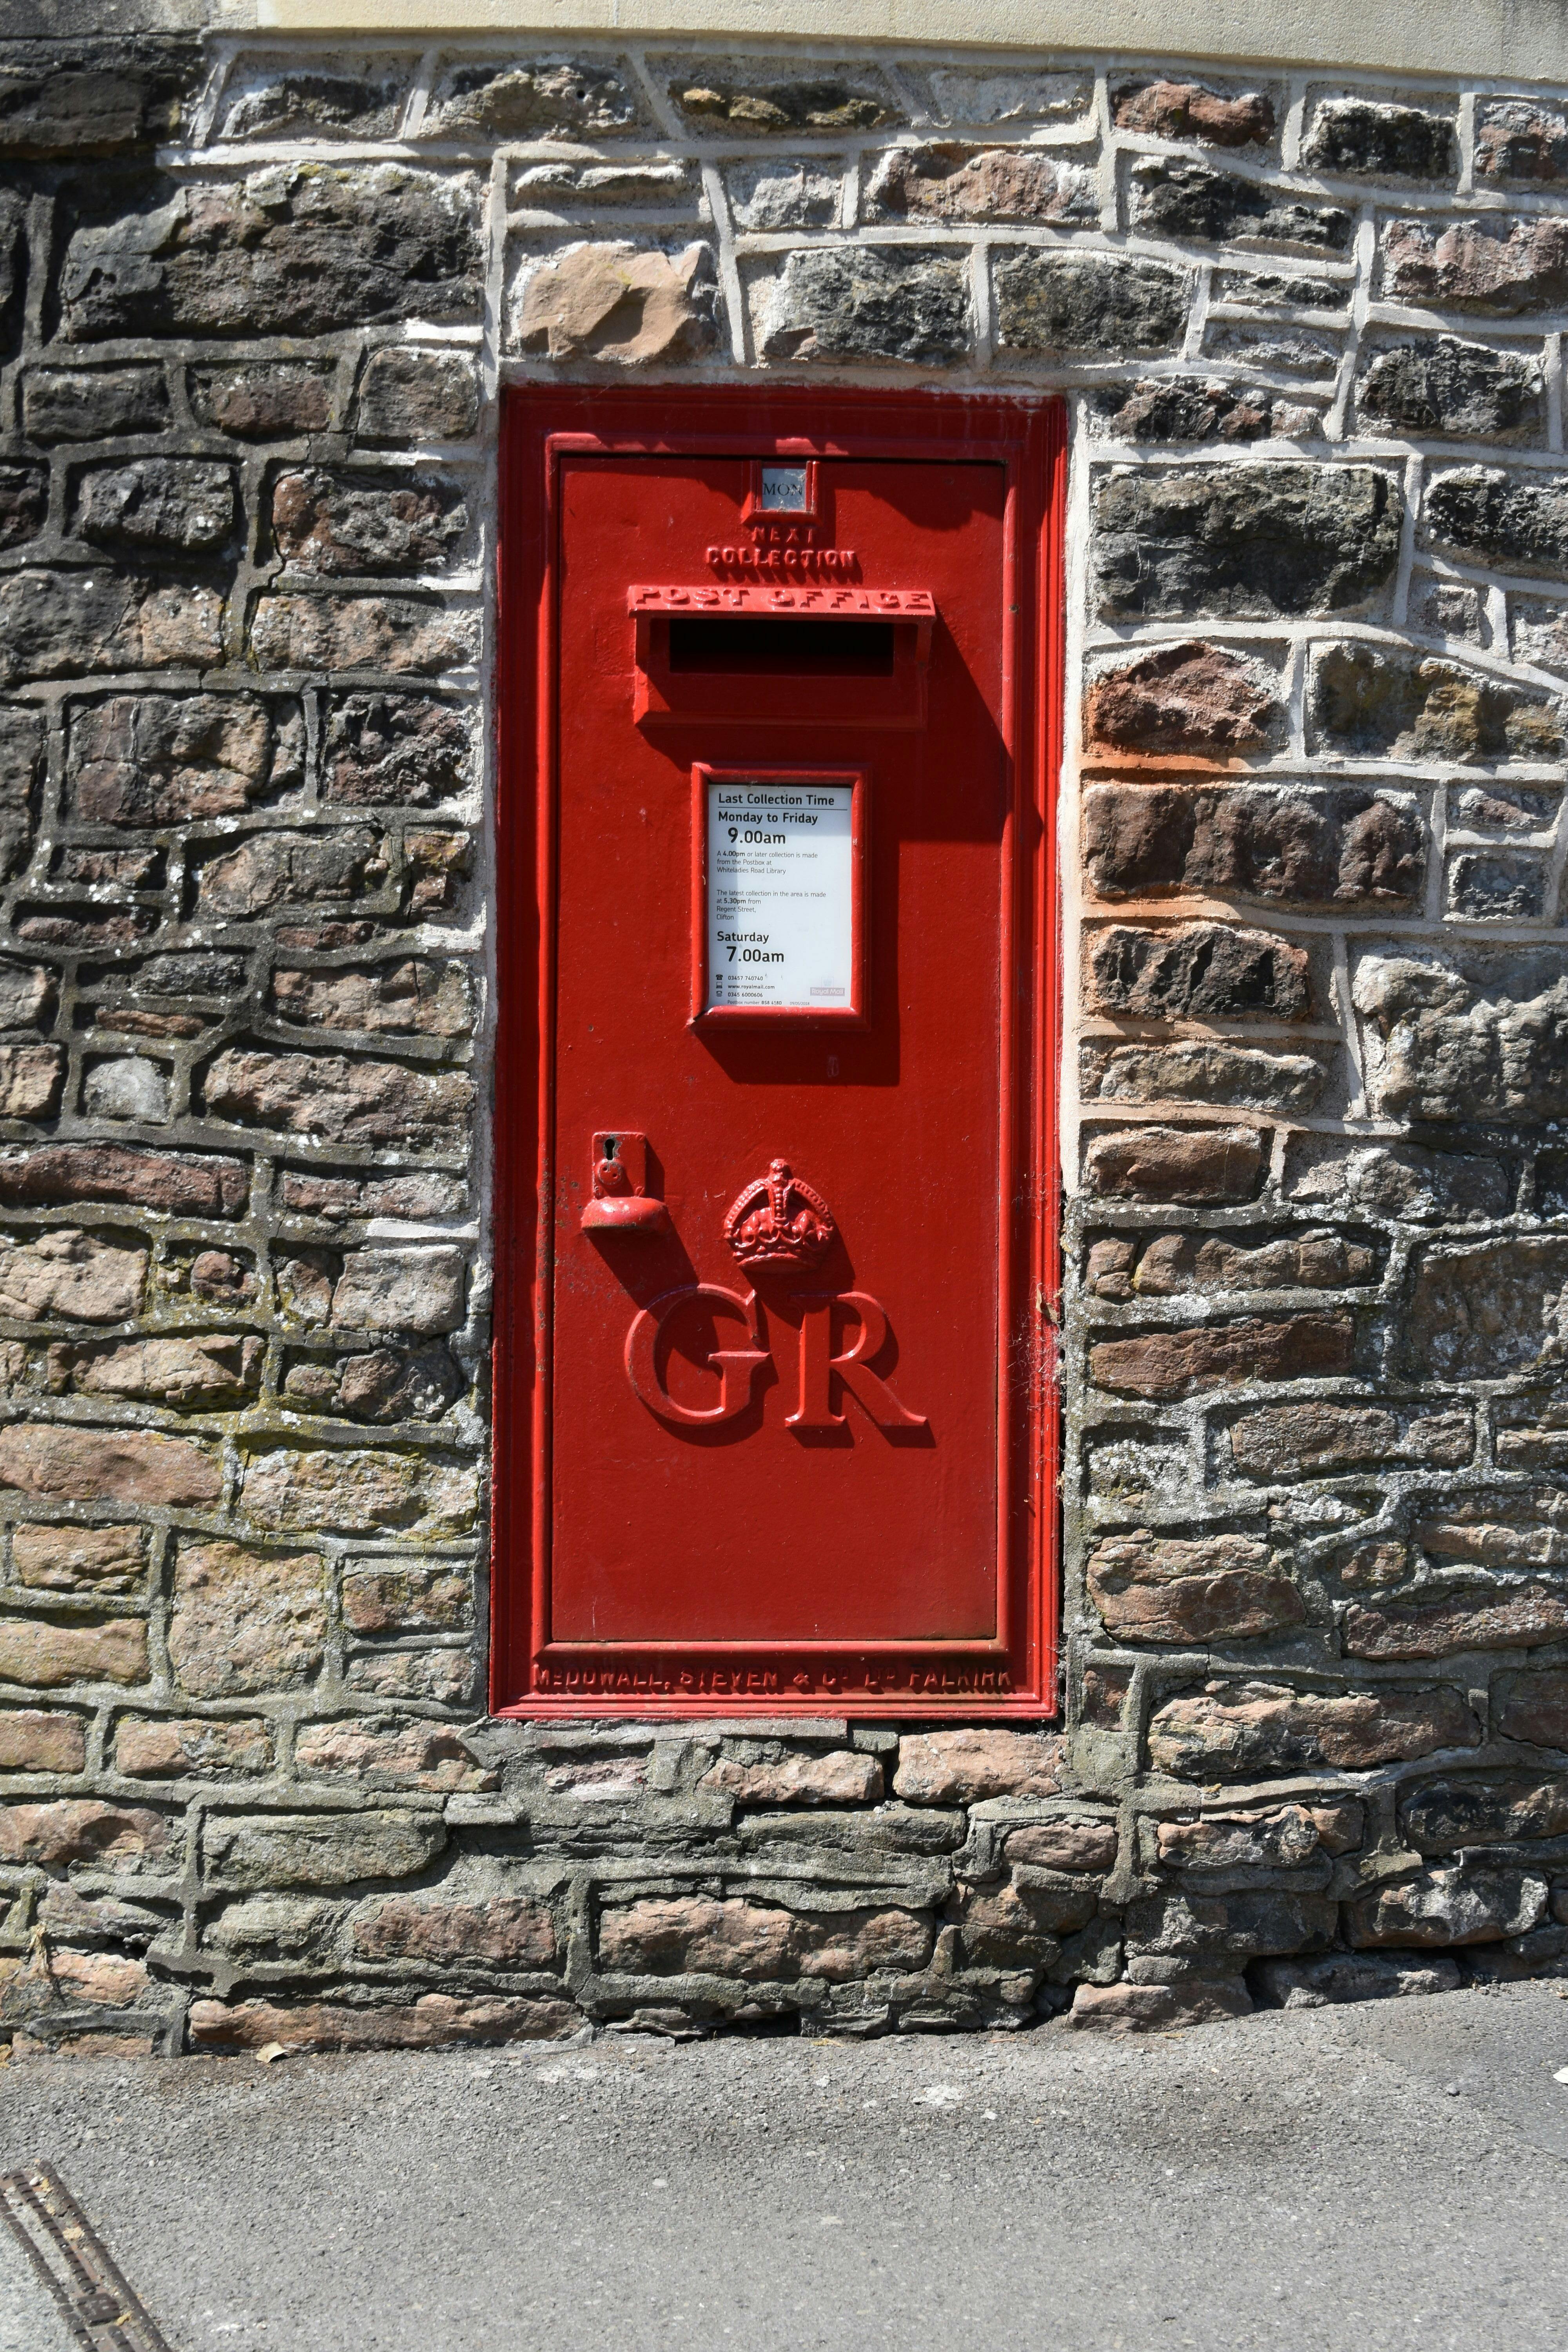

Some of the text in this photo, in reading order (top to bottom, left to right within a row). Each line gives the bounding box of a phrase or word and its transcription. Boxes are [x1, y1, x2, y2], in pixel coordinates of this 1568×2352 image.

[763, 483, 803, 497] MON
[750, 526, 815, 544] NEXT
[706, 547, 855, 568] COLLECTION
[635, 588, 932, 610] POST OFFICE
[719, 793, 835, 805] Last Collection Time
[719, 811, 818, 826] Monday to Friday
[728, 827, 786, 844] 9.00am
[717, 931, 769, 944] Saturday
[726, 946, 784, 962] 7.00am
[624, 1283, 926, 1428] GR
[679, 1666, 778, 1687] STEVEN
[793, 1667, 809, 1685] &
[908, 1665, 1013, 1686] FALKIRK
